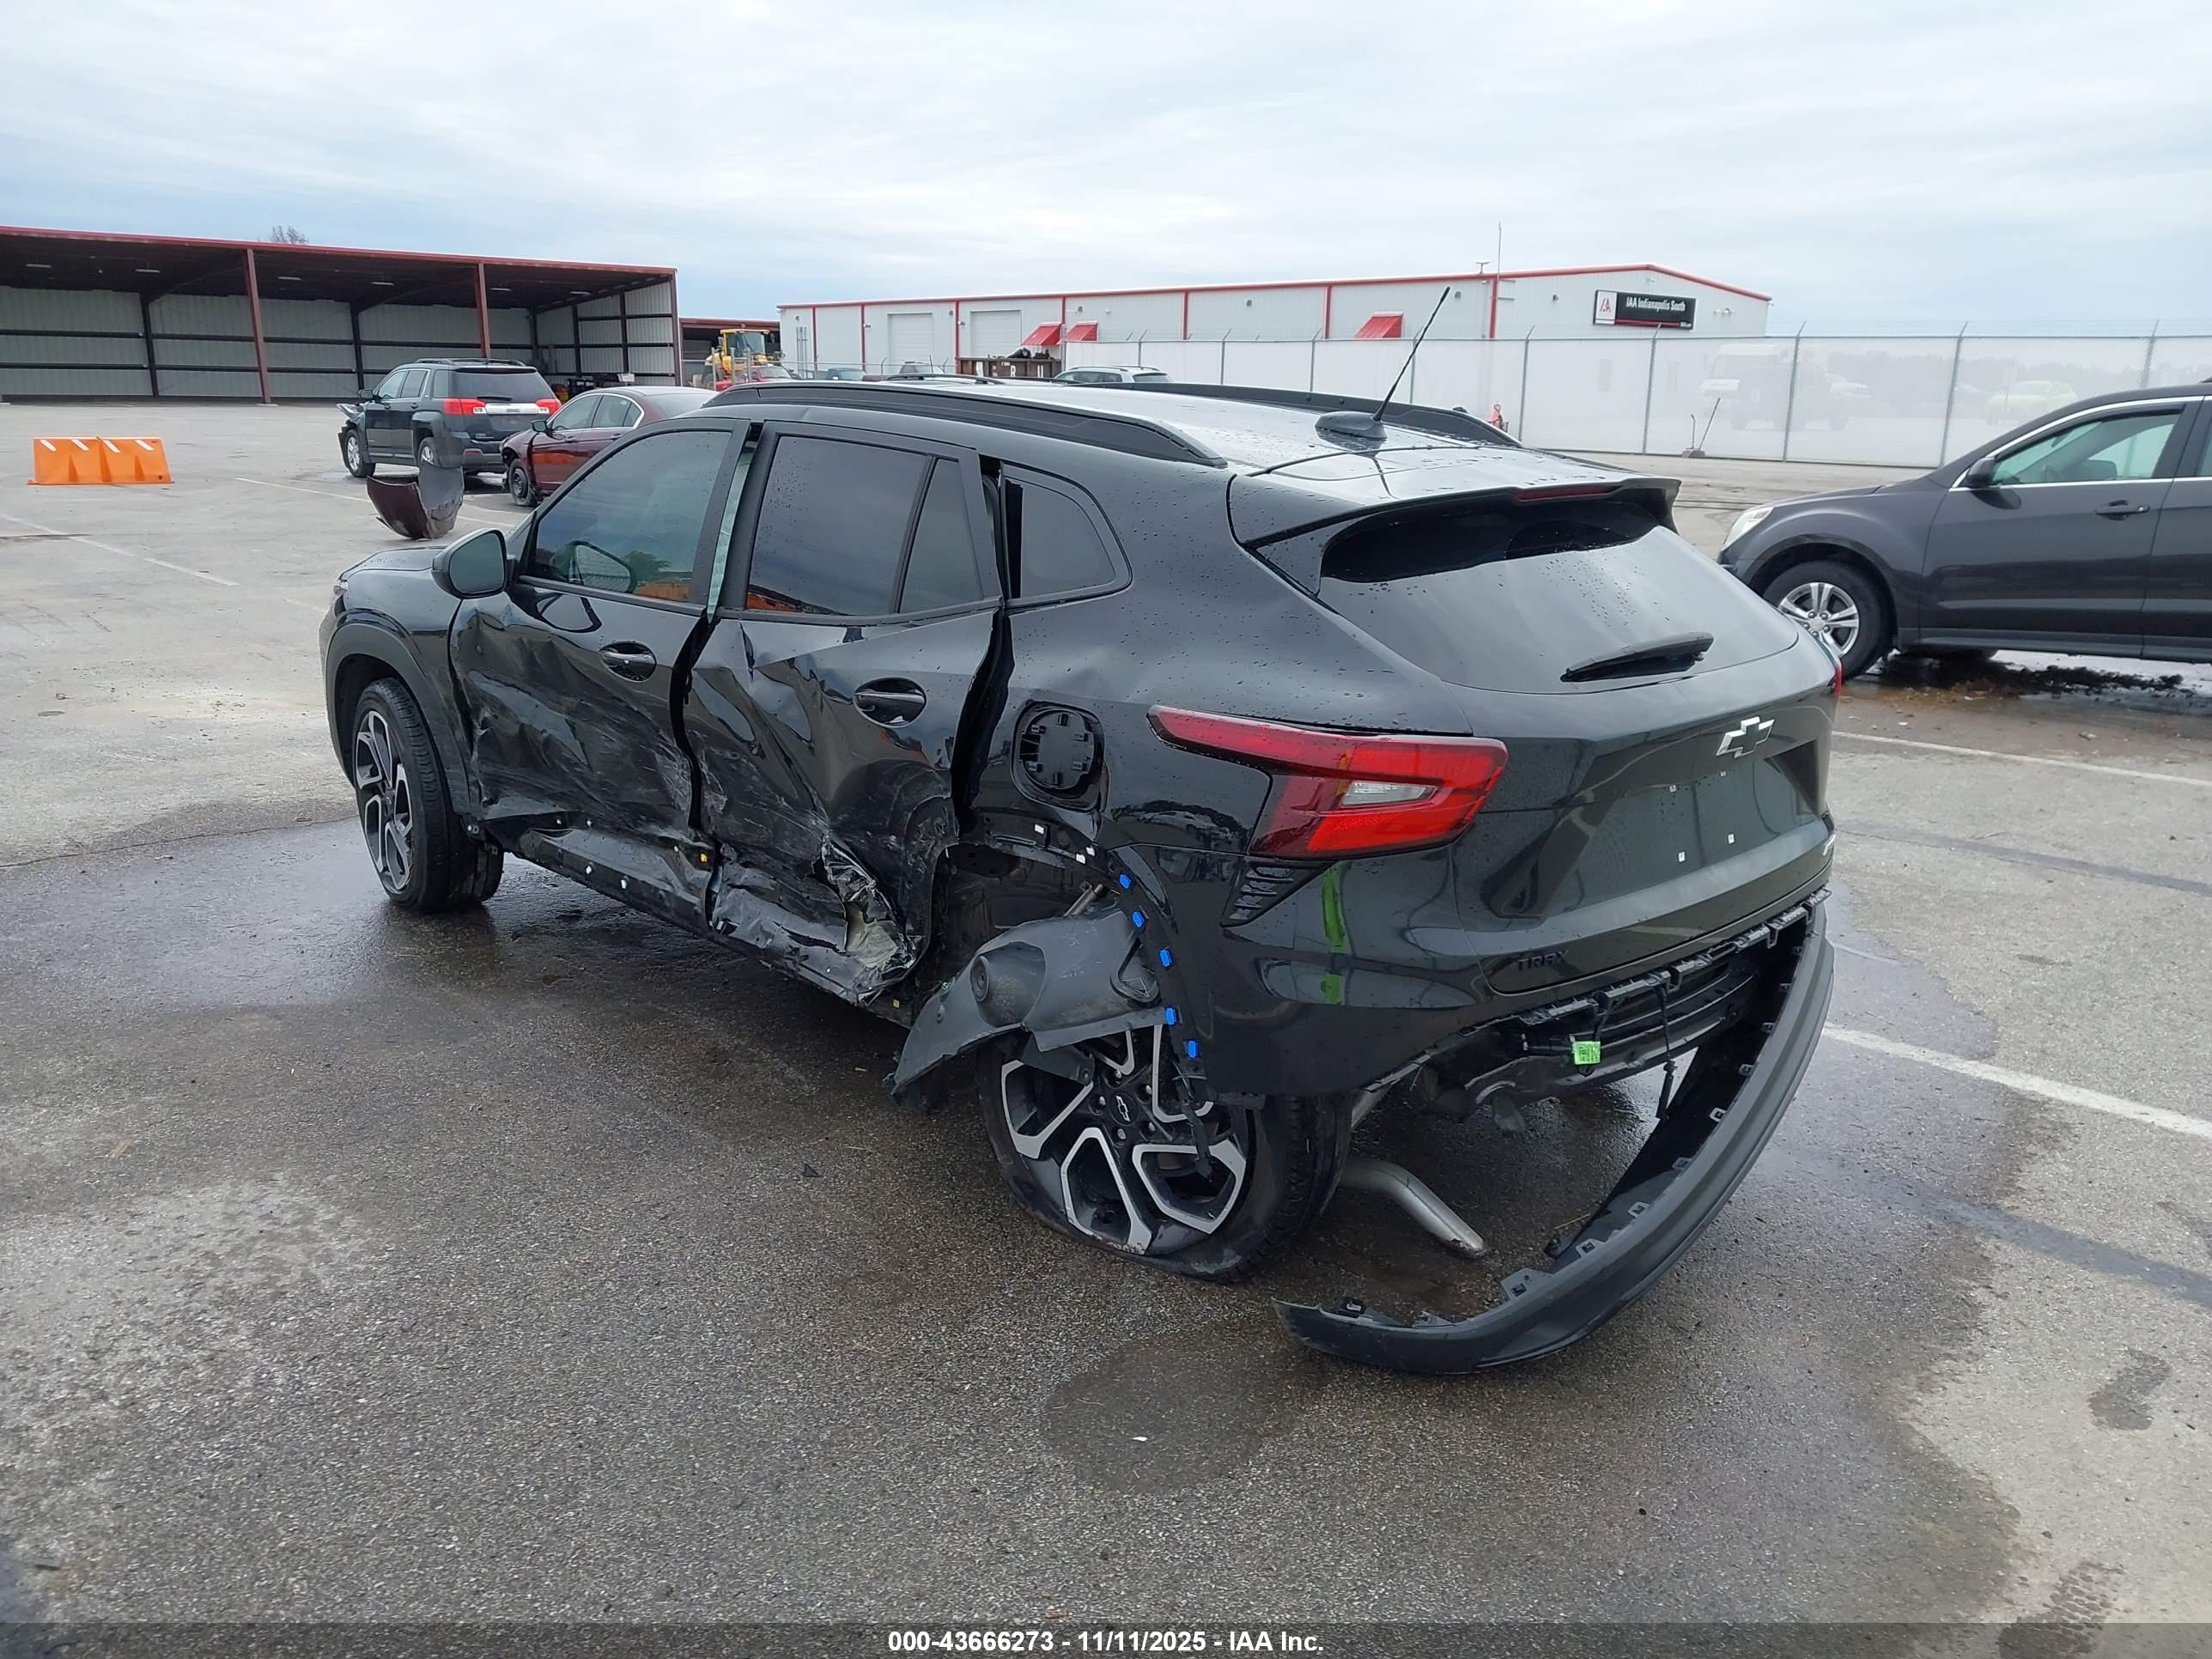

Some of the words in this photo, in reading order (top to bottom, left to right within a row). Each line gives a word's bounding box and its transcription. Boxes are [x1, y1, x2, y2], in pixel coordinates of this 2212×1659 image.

[1626, 296, 1637, 307] IAA
[1638, 297, 1670, 313] Indianapolis
[1670, 300, 1686, 312] South
[1517, 950, 1569, 971] TRAX
